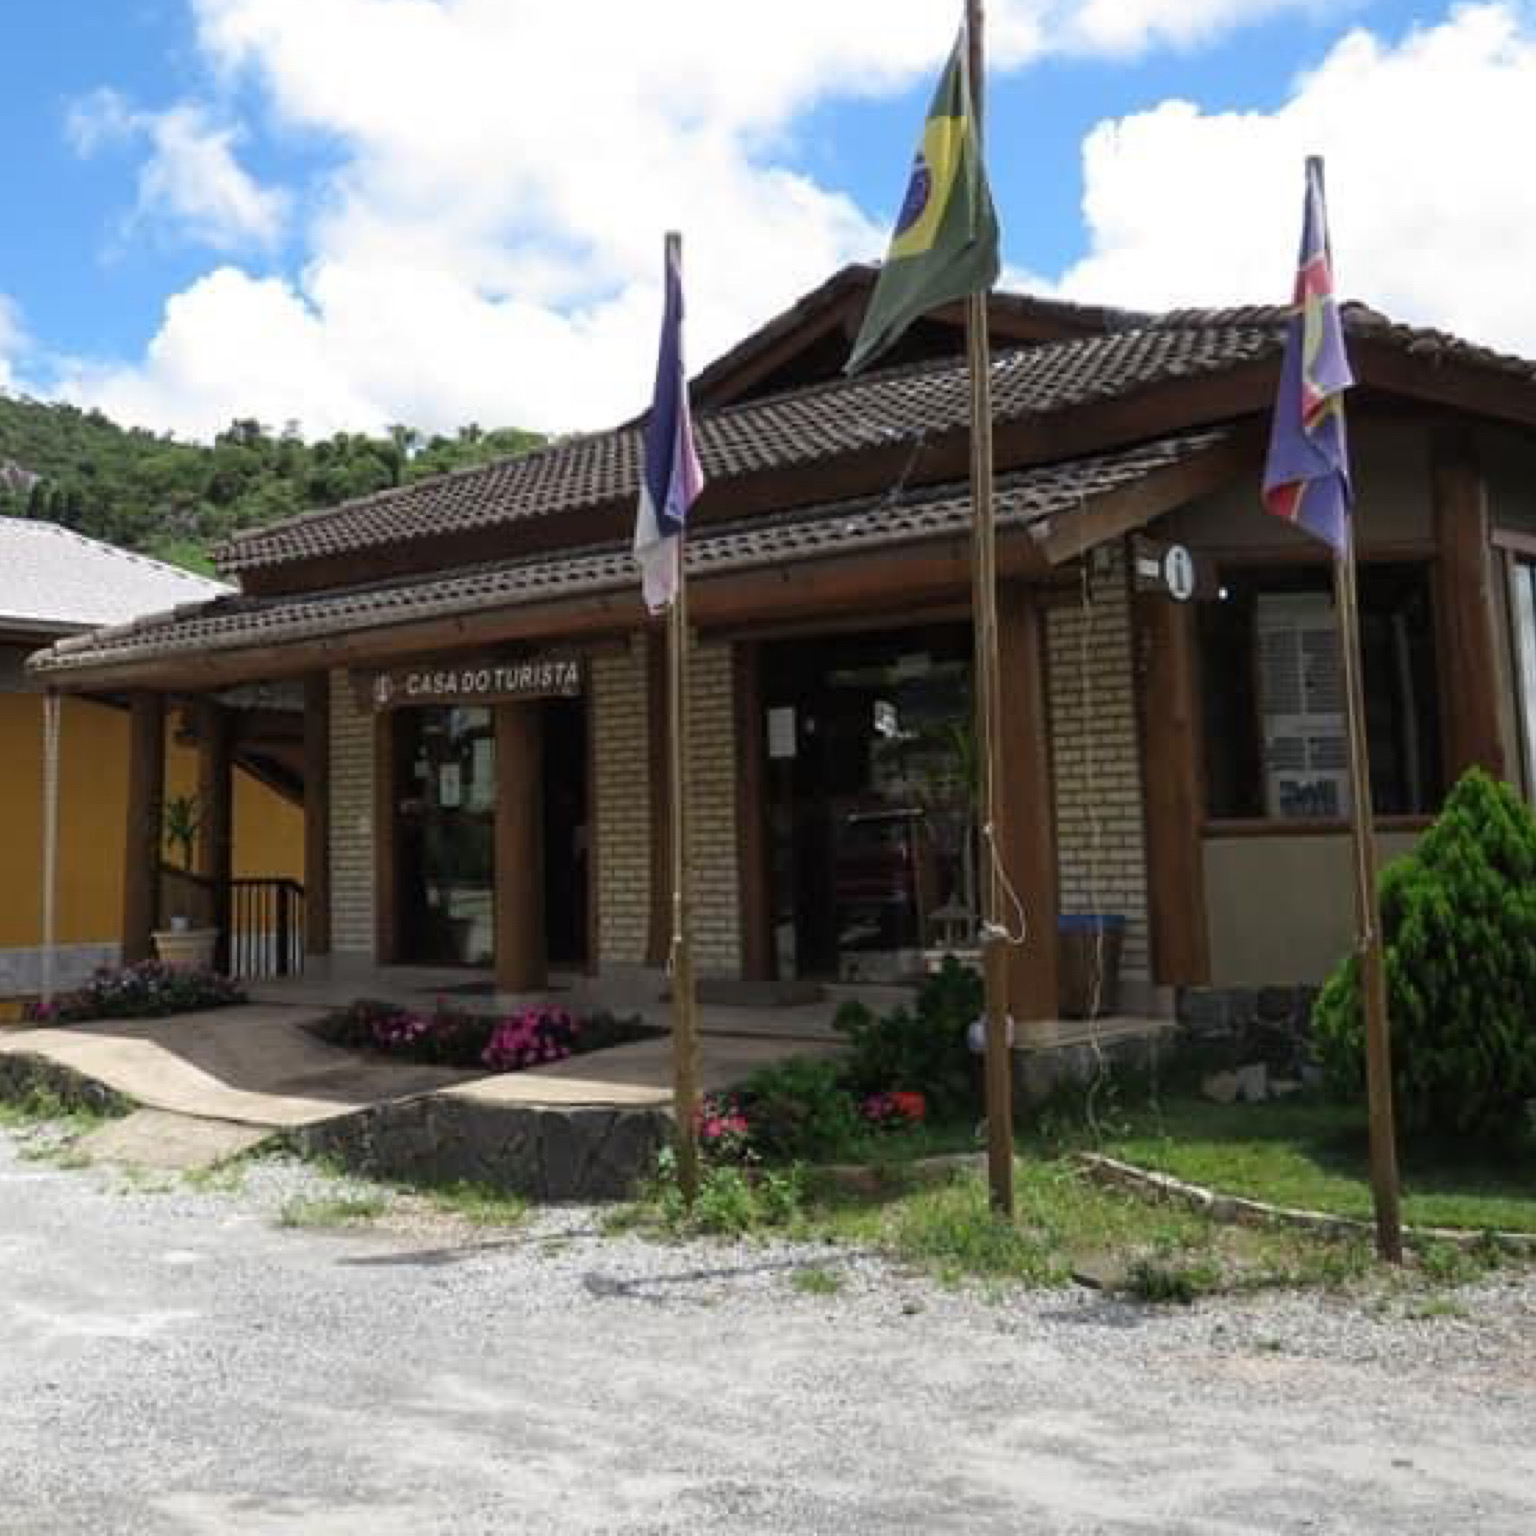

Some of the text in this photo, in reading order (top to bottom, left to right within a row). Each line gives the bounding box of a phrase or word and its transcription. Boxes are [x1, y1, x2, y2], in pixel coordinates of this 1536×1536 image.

[406, 661, 579, 695] CASA DO TURISTA
